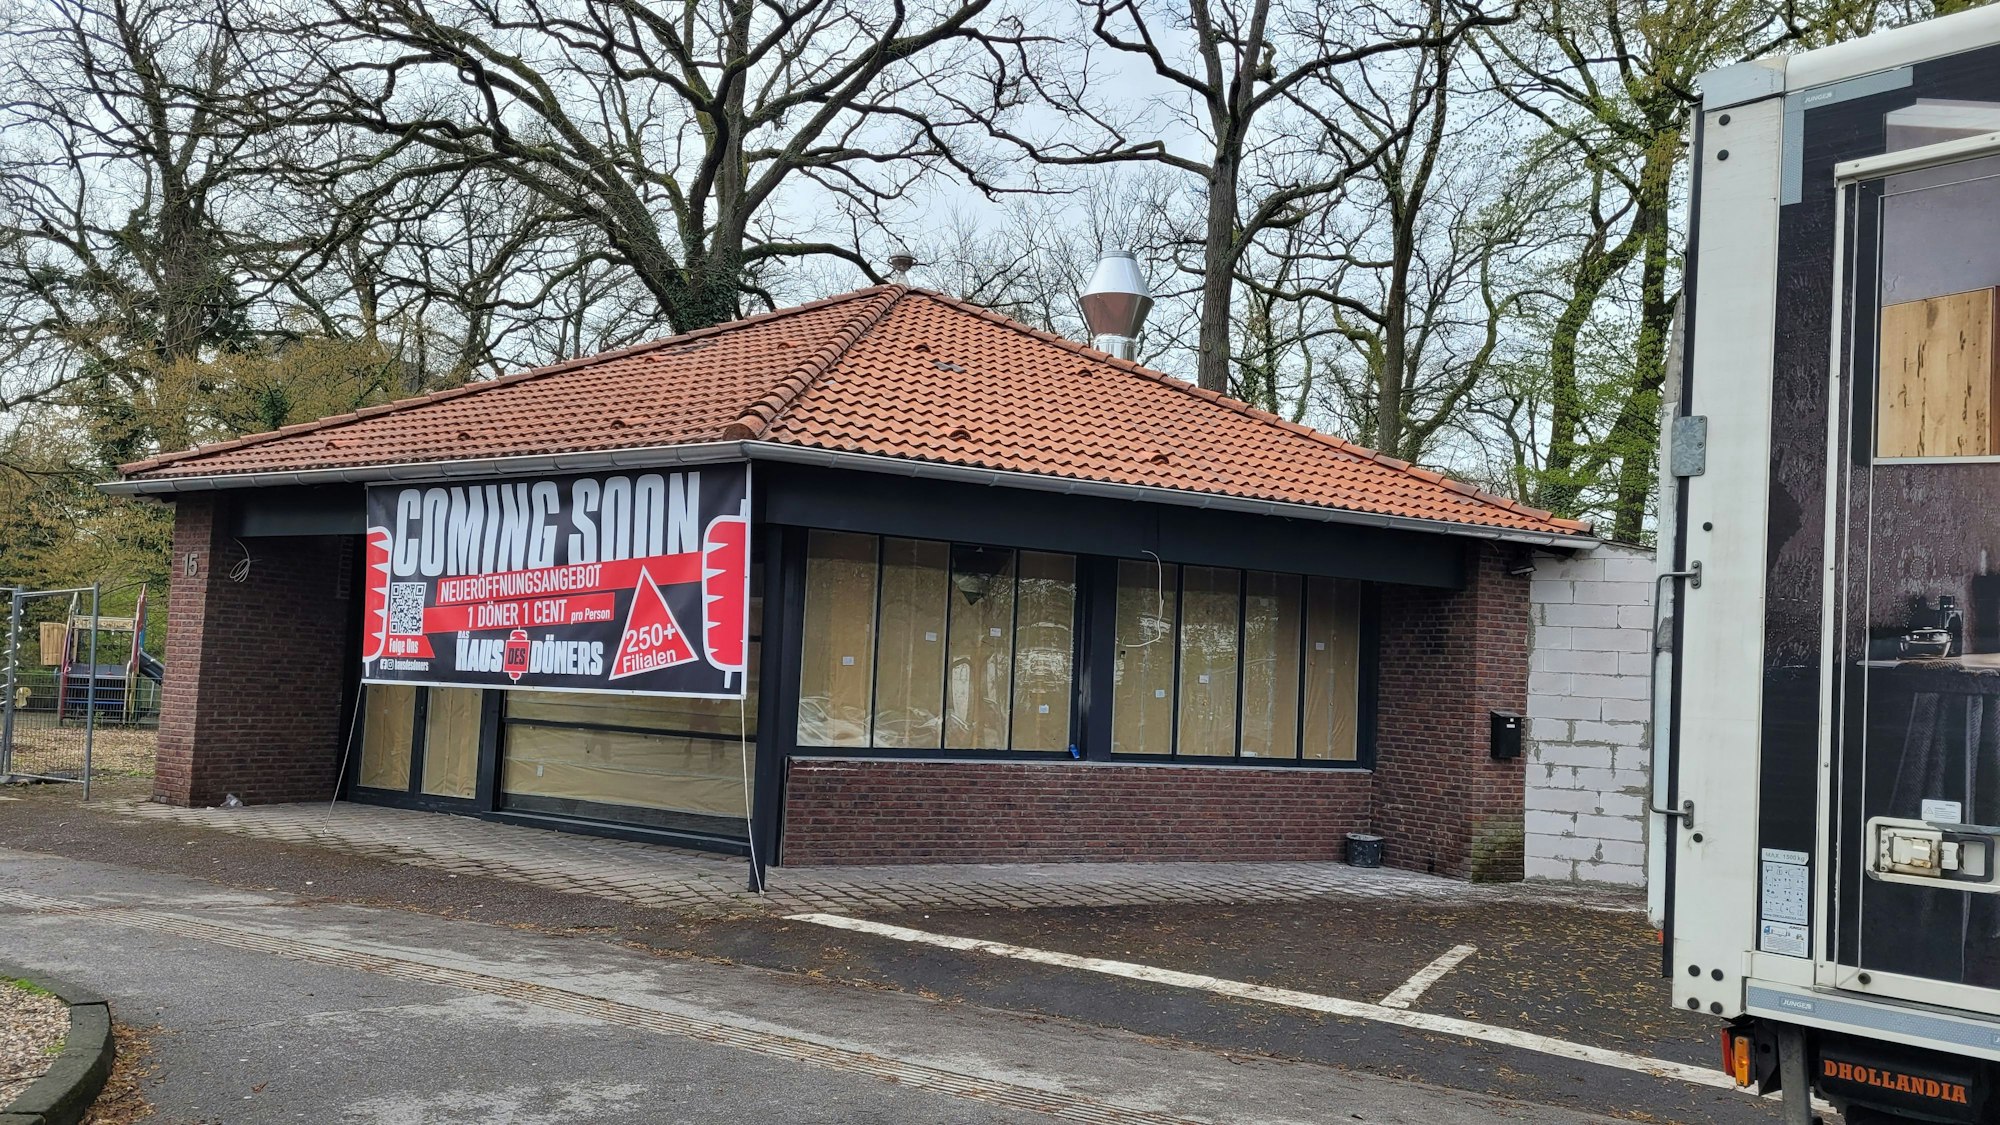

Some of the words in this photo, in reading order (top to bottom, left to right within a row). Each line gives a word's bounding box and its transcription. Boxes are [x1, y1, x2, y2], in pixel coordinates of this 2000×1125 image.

[393, 481, 560, 577] COMING
[568, 471, 700, 564] SOON
[182, 553, 199, 577] 15
[440, 564, 602, 603] NEUERÖFFNUNGSANGEBOT
[467, 606, 474, 628] 1
[477, 600, 519, 627] DÖNER
[522, 602, 530, 624] 1
[533, 599, 568, 623] CENT
[570, 611, 584, 625] pro
[584, 607, 611, 621] Person
[388, 638, 406, 656] Folge
[457, 630, 471, 639] DAS
[626, 623, 676, 653] 250+
[455, 636, 504, 673] HAUS
[508, 647, 526, 666] DES
[529, 634, 603, 676] DÖNERS
[622, 649, 677, 673] Filialen
[1823, 1059, 1968, 1105] DHOLLANDIA
